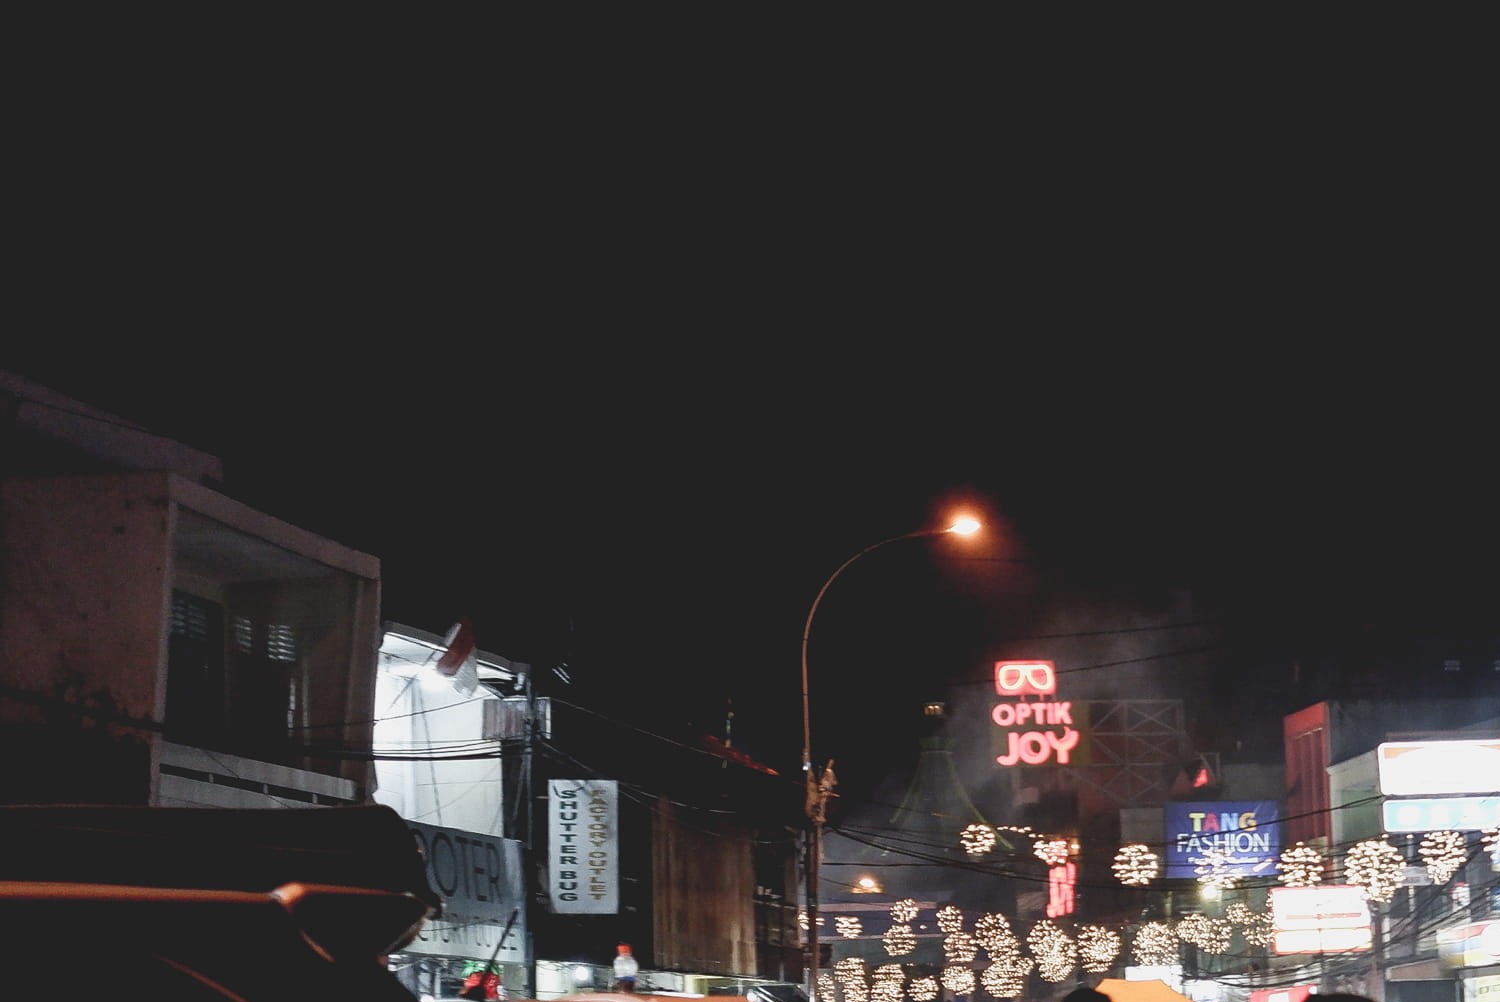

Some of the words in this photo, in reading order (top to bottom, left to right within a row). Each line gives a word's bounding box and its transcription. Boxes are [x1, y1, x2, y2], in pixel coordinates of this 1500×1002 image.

[991, 701, 1073, 727] OPTIK
[996, 726, 1080, 766] JOY
[558, 788, 579, 865] SHUTTER
[1188, 811, 1258, 832] TANG
[1176, 832, 1271, 854] FASHION
[558, 870, 579, 902] BUG
[588, 851, 608, 901] OUTLET
